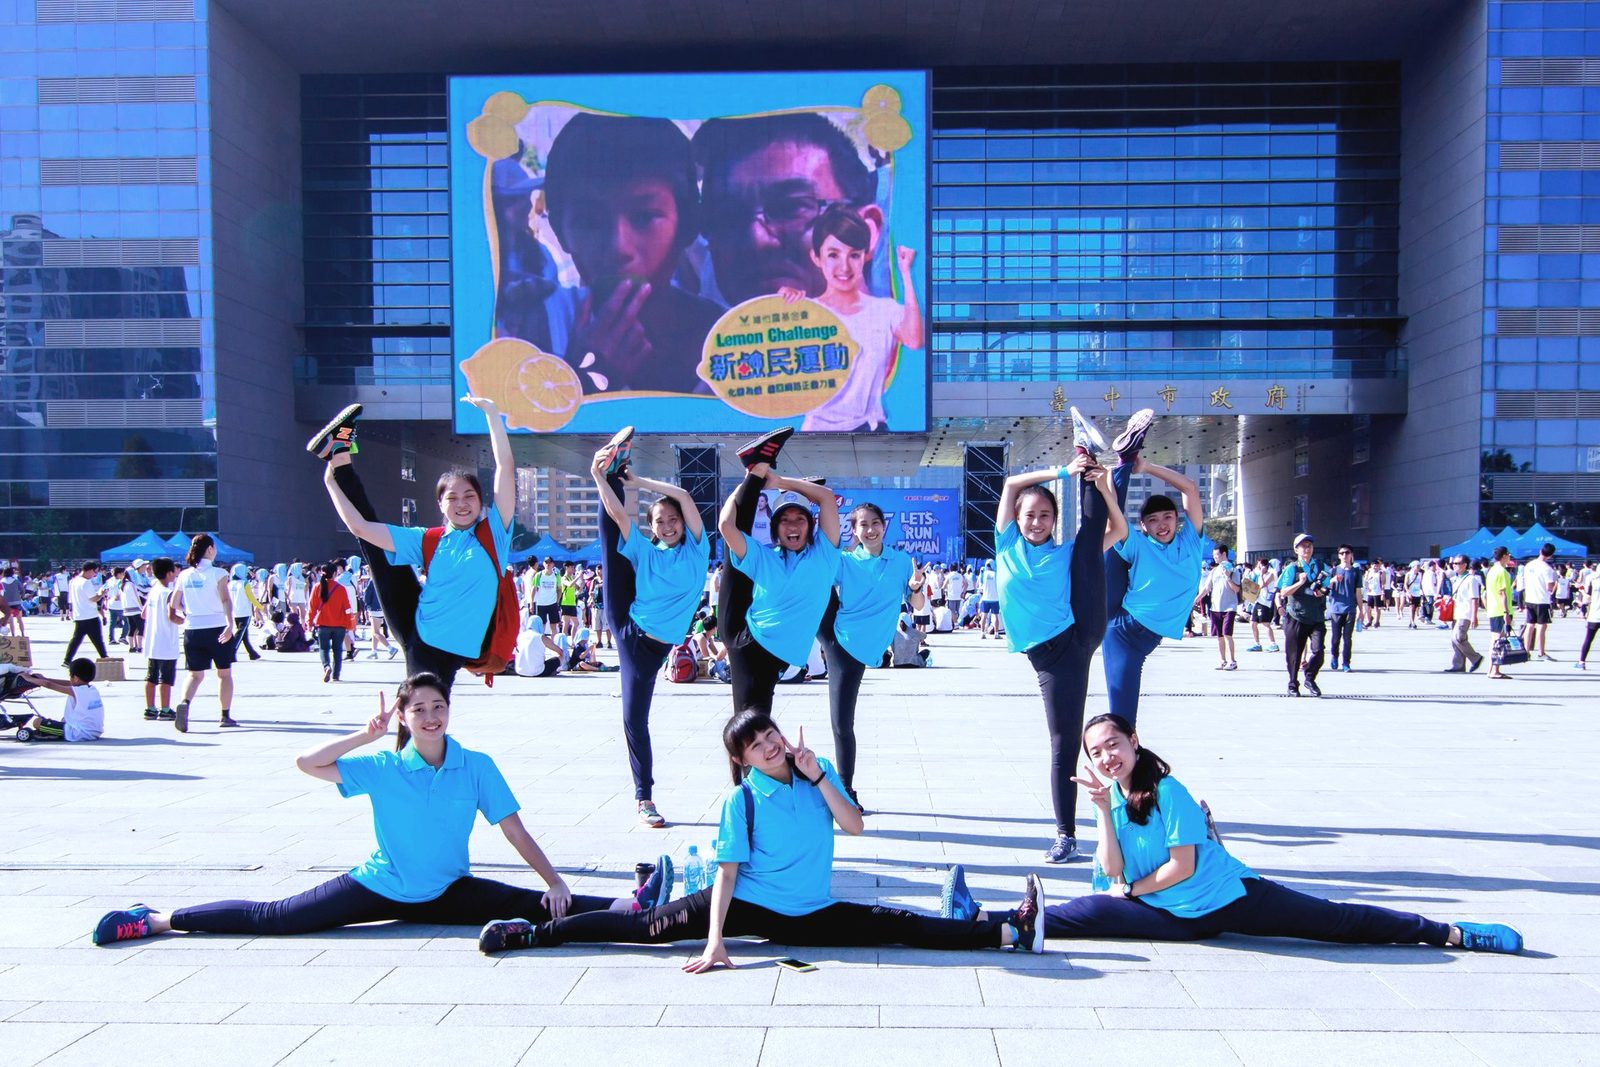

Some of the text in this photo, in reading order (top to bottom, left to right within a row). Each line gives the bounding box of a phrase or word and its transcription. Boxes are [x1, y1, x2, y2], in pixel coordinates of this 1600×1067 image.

[716, 325, 837, 348] Lemon Challenge
[1049, 384, 1288, 412] 臺中市政府
[905, 526, 932, 539] RUN
